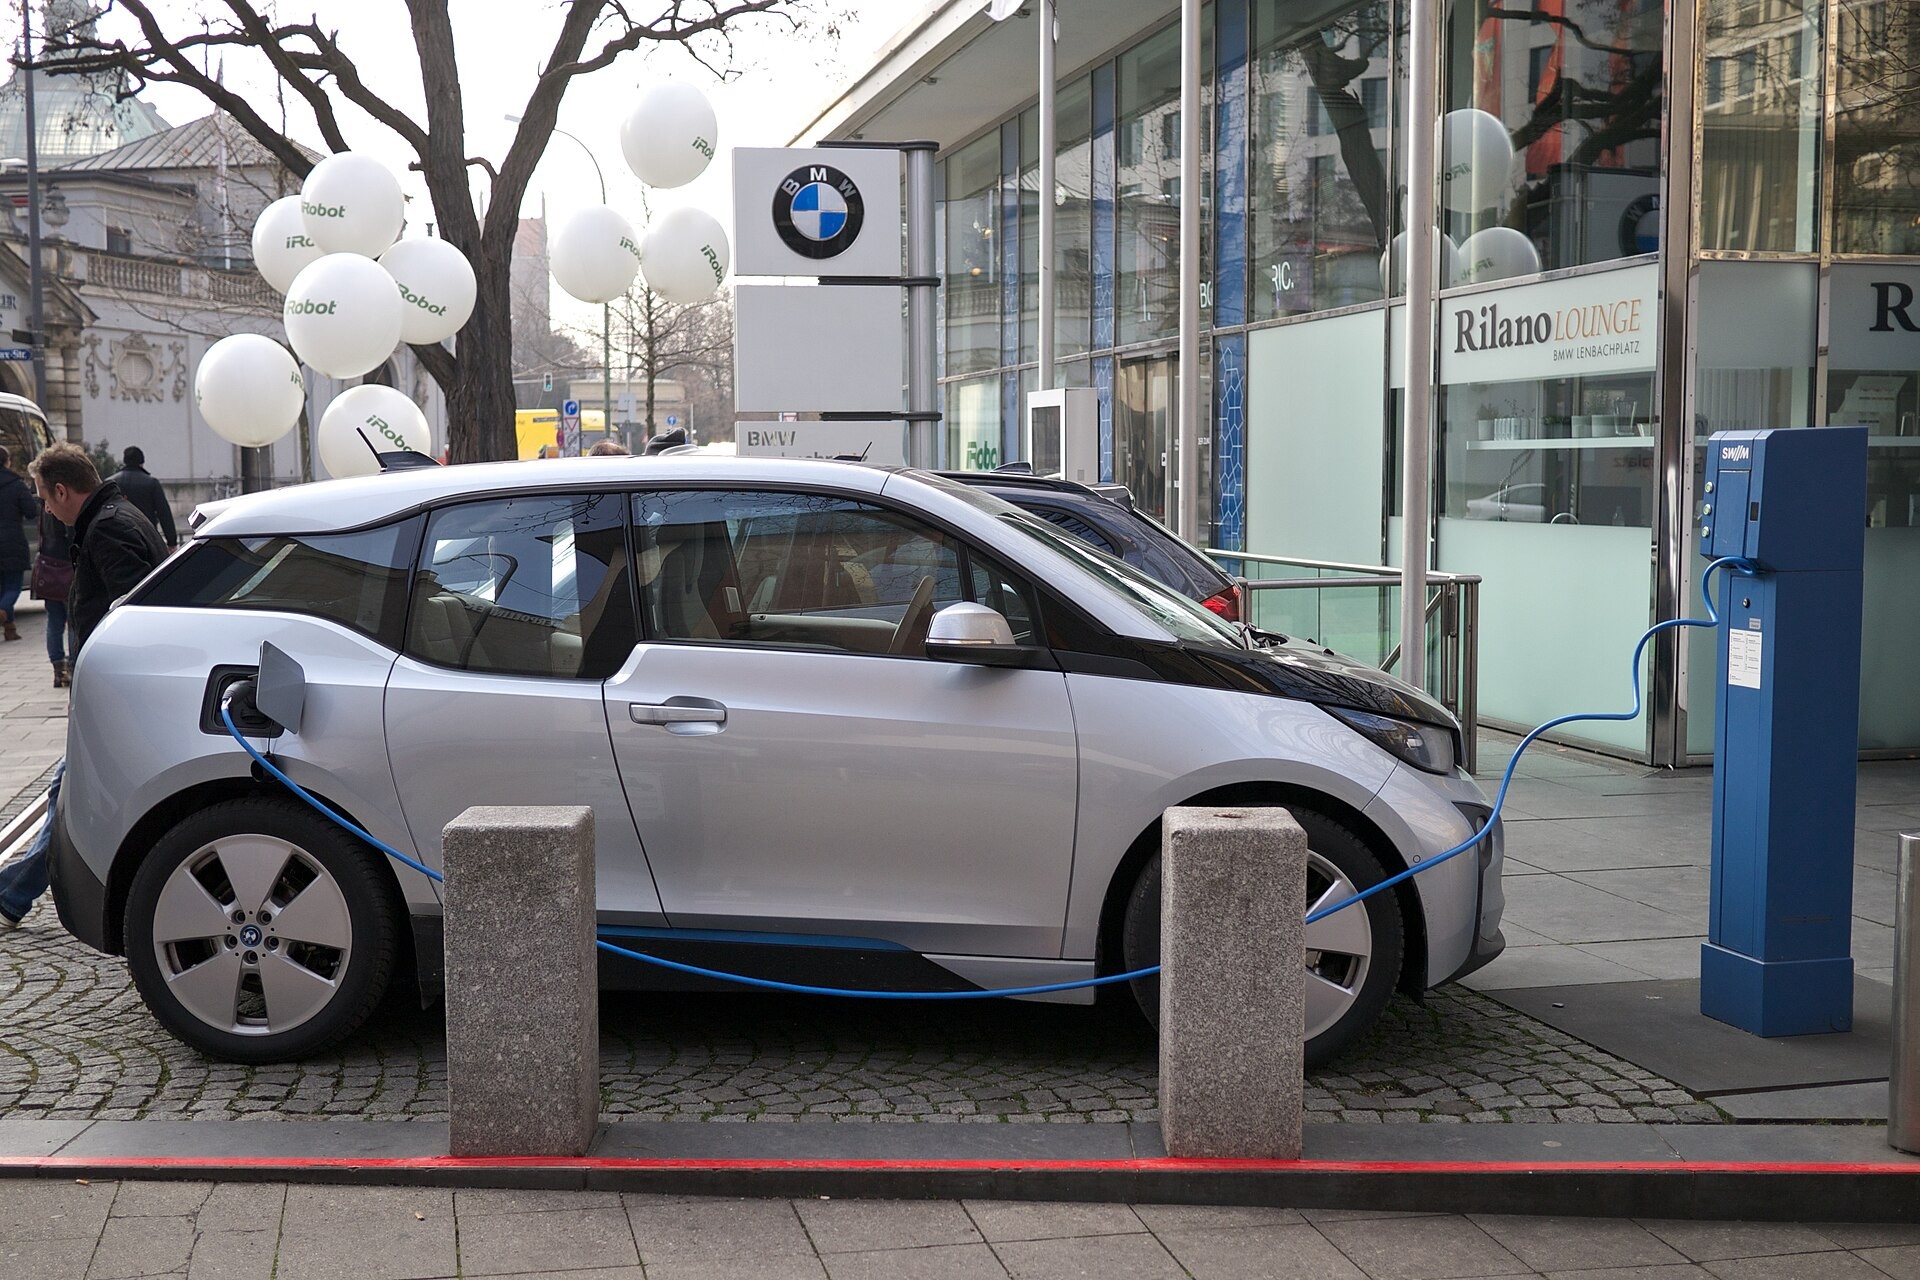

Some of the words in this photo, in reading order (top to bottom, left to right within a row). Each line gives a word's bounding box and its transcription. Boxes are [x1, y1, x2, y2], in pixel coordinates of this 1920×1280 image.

[781, 167, 857, 198] BMW
[1869, 282, 1920, 332] R
[1454, 303, 1552, 354] Rilano
[1554, 299, 1642, 341] LOUNGE
[1553, 349, 1574, 362] BMW
[1576, 341, 1640, 360] LENBACHPLATZ
[748, 431, 796, 446] BMW
